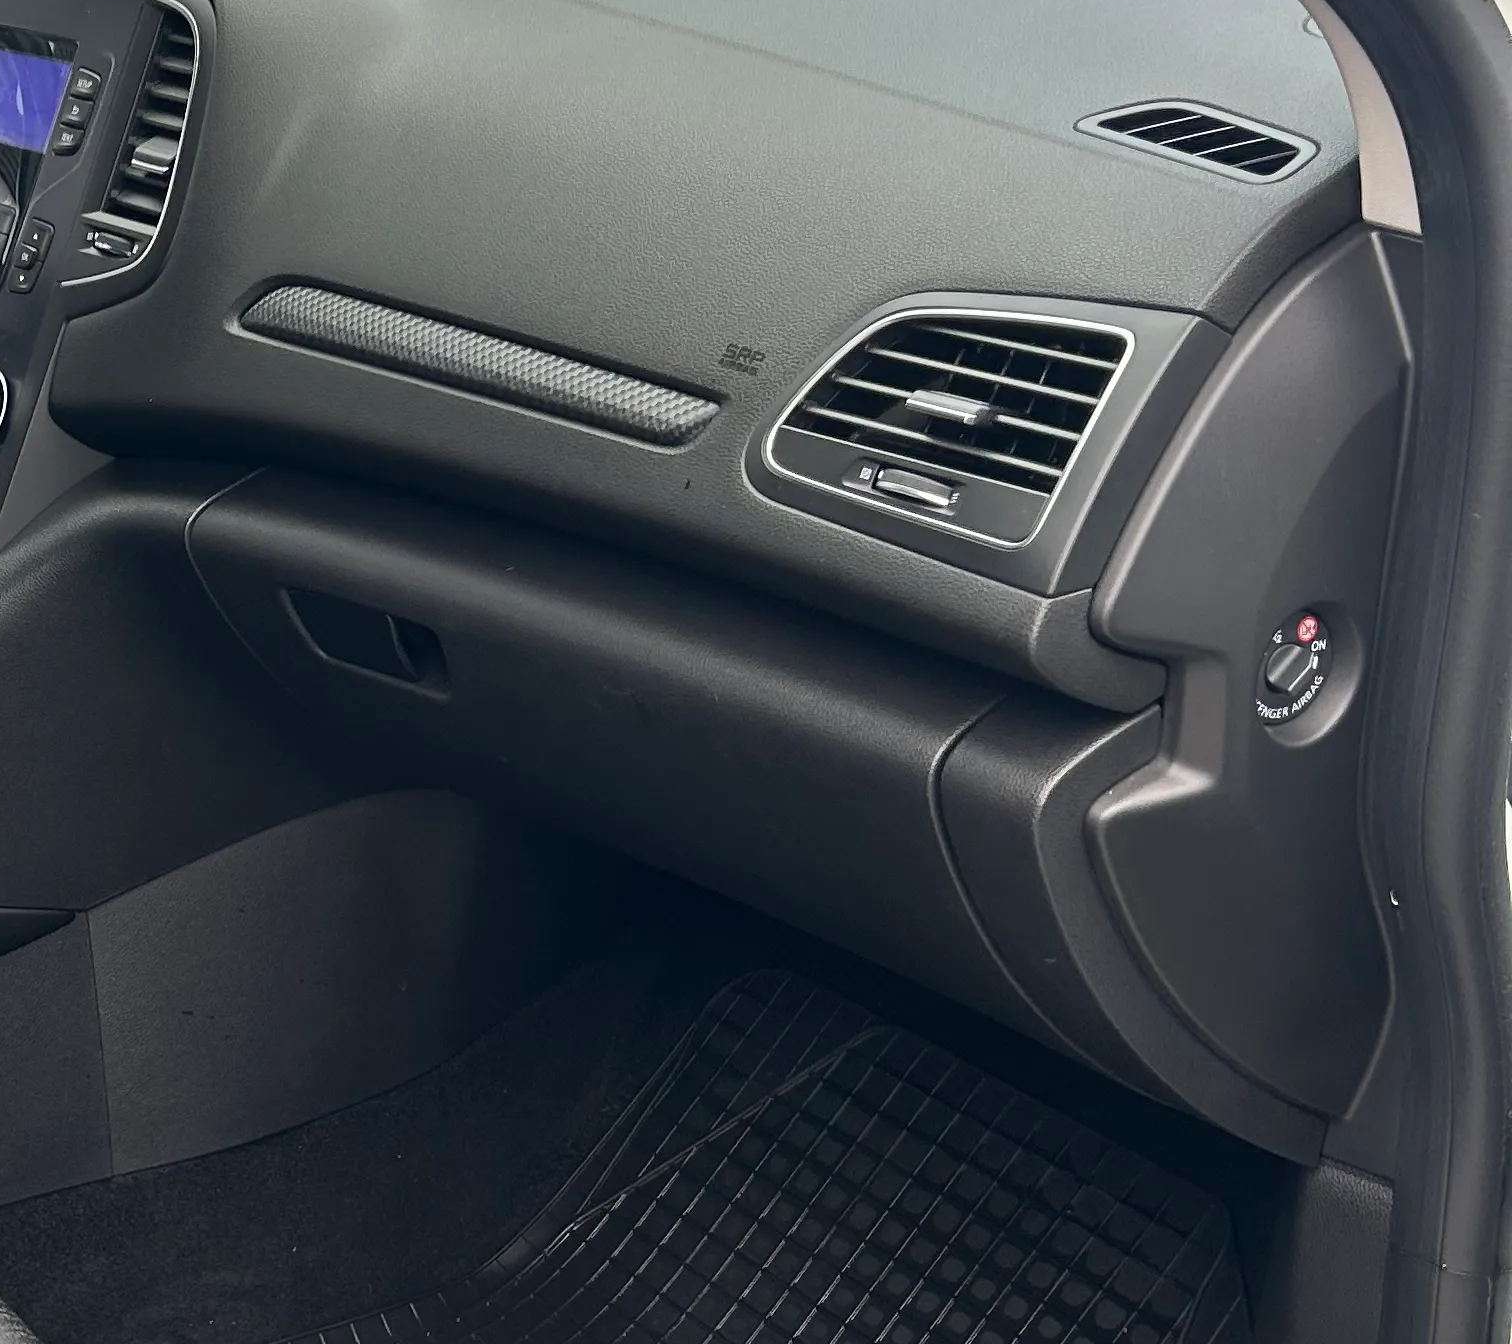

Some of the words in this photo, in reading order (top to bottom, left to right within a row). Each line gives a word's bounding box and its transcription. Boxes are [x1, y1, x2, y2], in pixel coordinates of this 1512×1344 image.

[1311, 639, 1327, 652] ON
[1256, 699, 1289, 719] ENGER
[1291, 675, 1324, 714] AIRBAG
